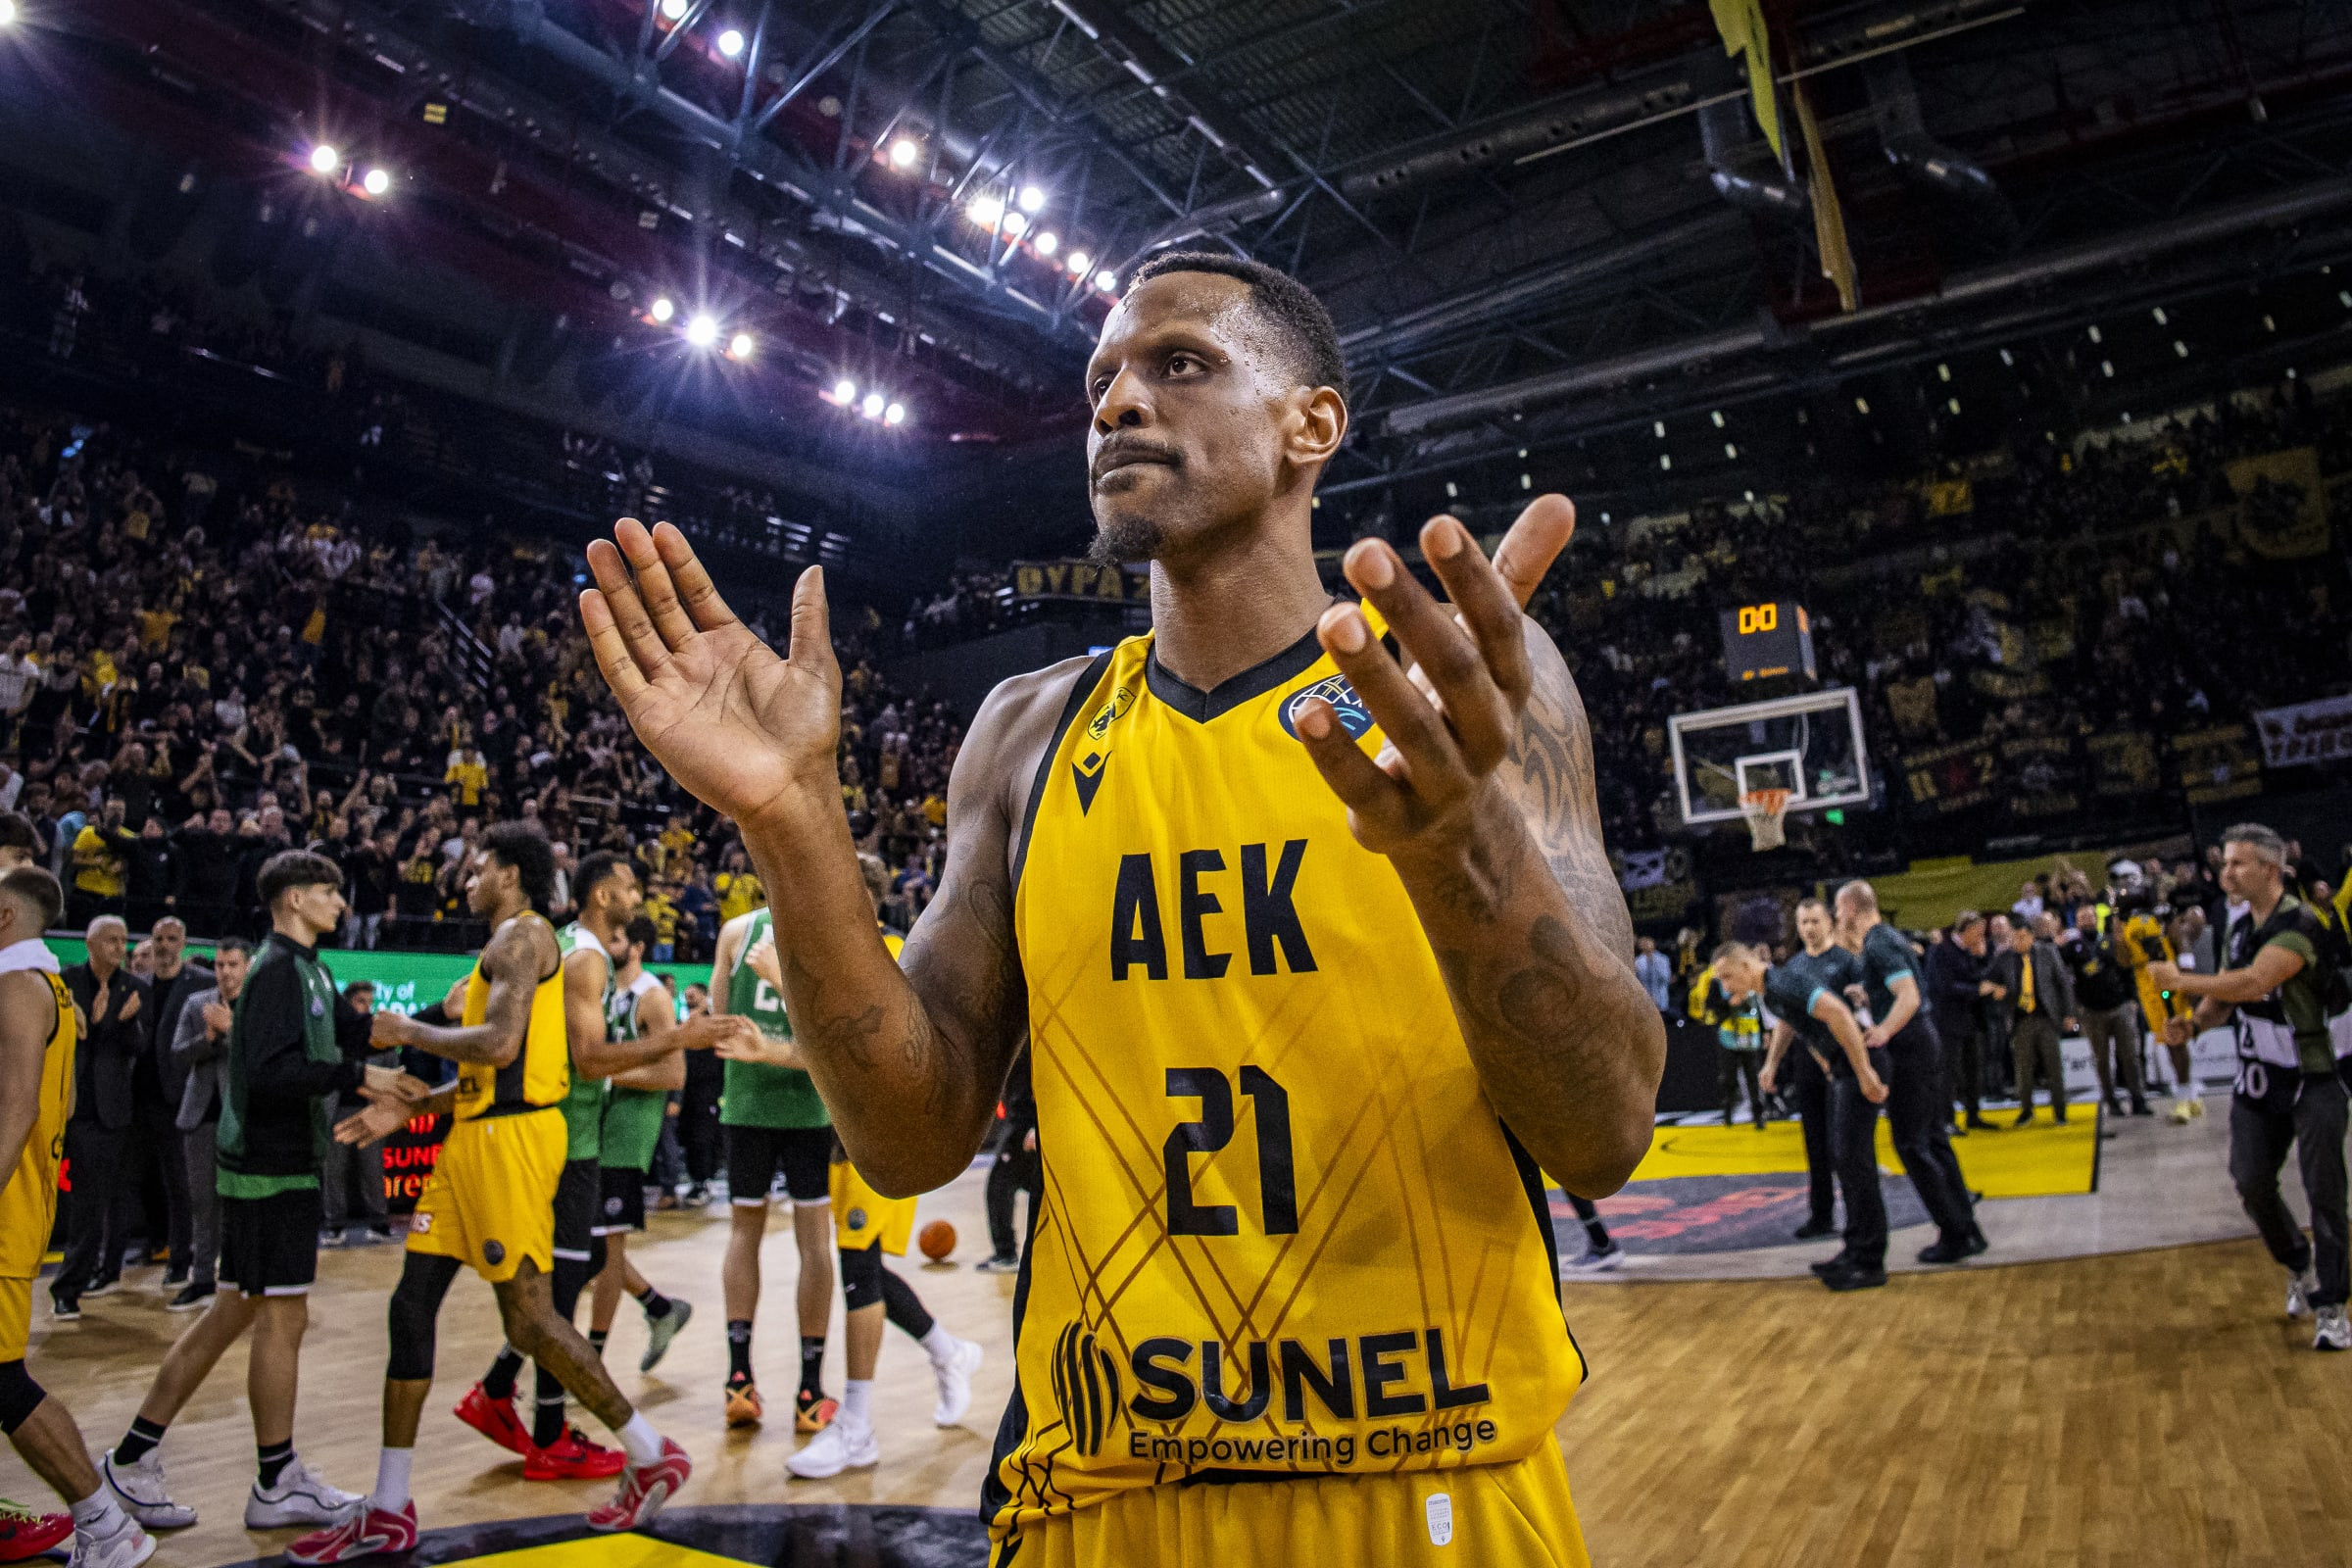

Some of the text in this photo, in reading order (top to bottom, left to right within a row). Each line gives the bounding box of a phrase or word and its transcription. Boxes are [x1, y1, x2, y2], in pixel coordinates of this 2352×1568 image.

[1110, 839, 1318, 981] AEK
[1162, 1064, 1298, 1236] 21
[1129, 1327, 1491, 1422] SUNEL
[1130, 1418, 1496, 1465] Empowering Change
